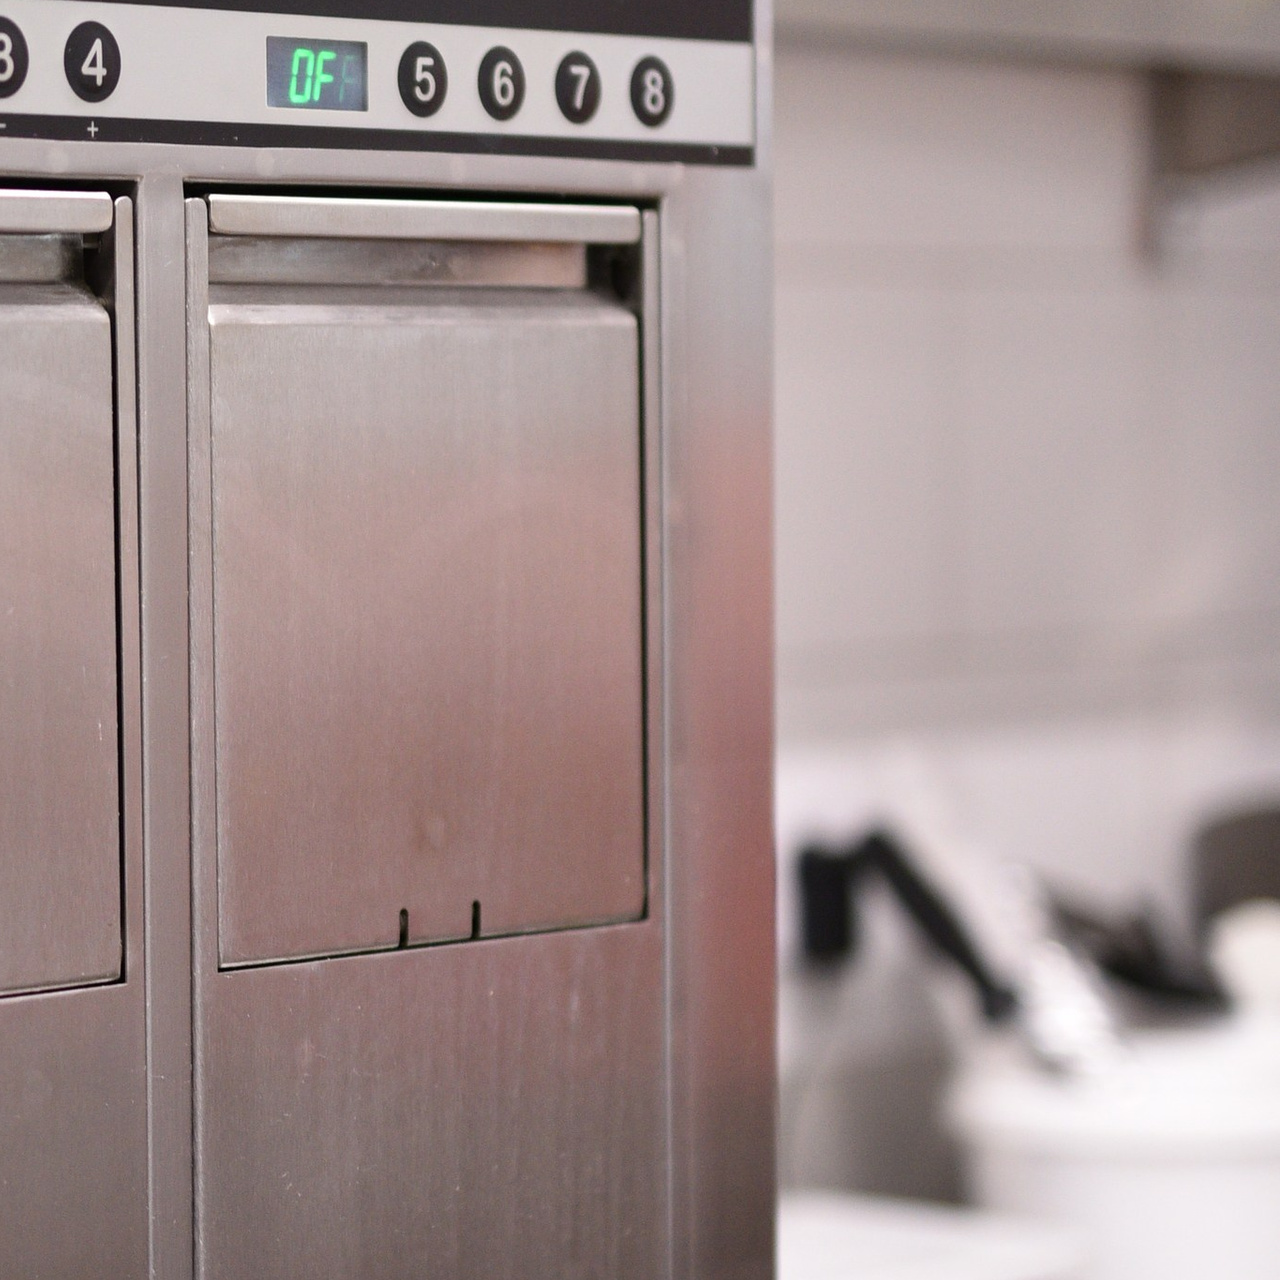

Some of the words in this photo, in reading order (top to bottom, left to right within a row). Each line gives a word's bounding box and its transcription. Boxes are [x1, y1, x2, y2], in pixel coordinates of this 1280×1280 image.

[80, 37, 108, 87] 4
[414, 56, 437, 103] 5
[491, 60, 516, 107] 6
[569, 64, 592, 111] 7
[641, 67, 666, 115] 8
